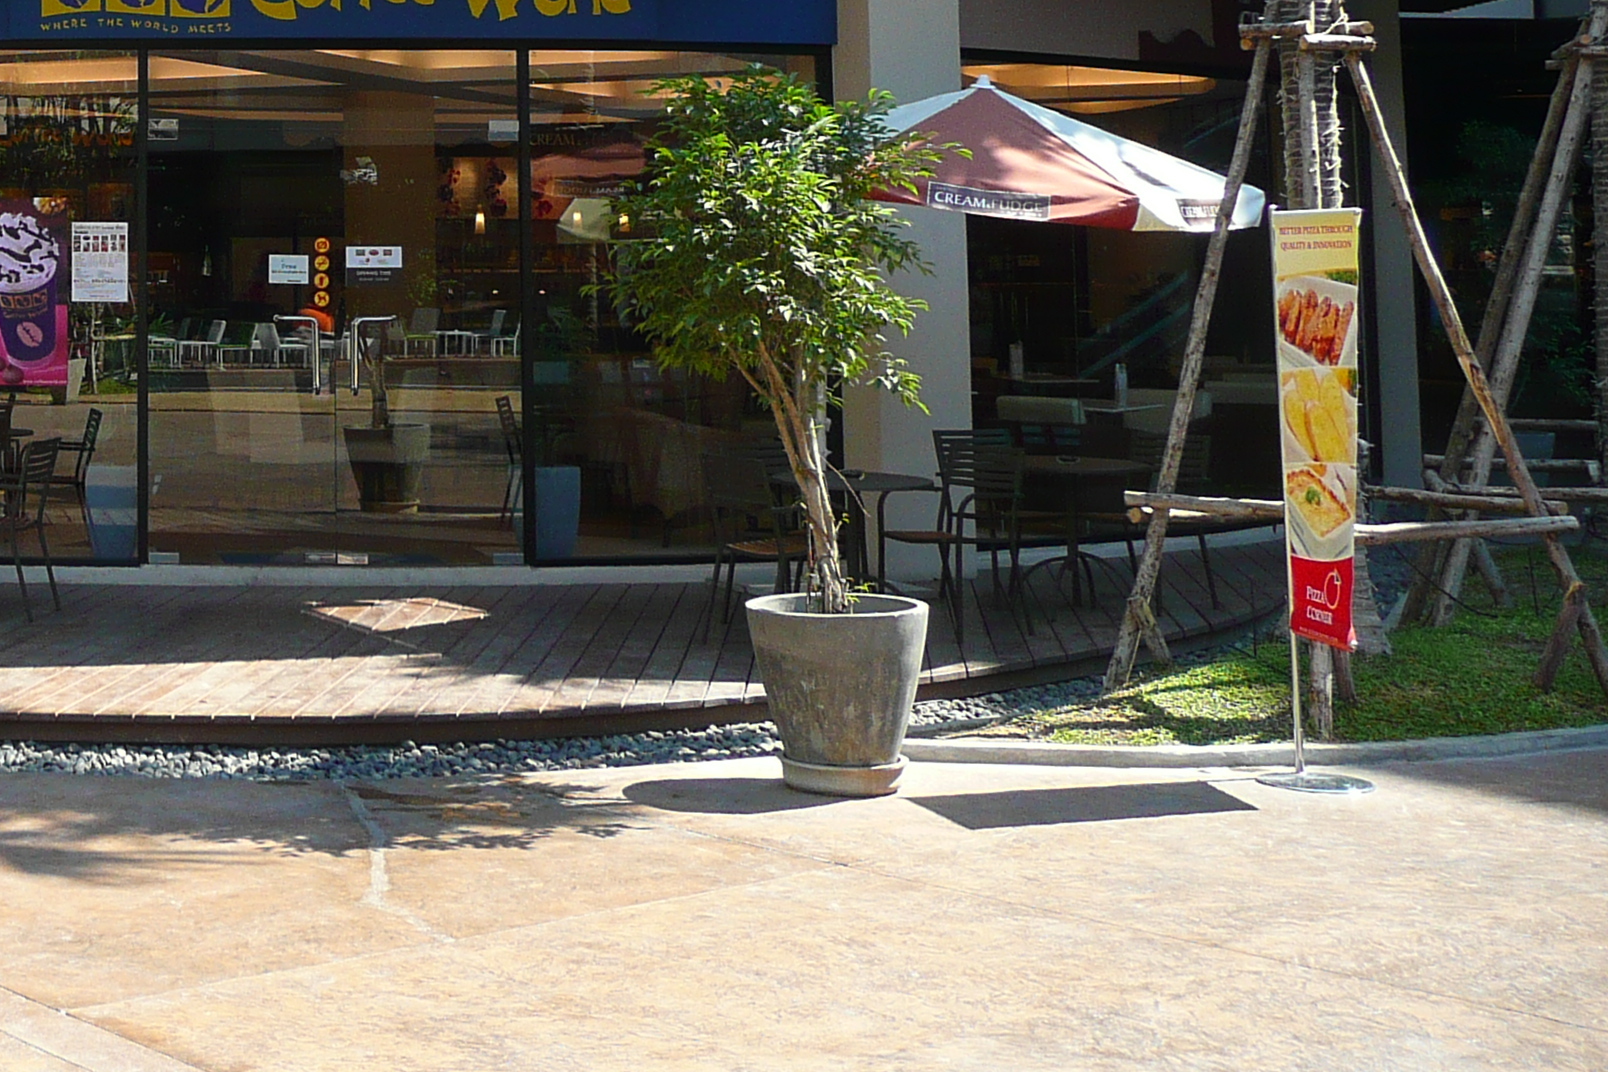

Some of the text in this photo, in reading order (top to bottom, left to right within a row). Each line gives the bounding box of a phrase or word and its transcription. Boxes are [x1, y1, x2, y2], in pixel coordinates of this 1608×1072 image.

[41, 18, 232, 33] WHERE THE WORLD MEETS
